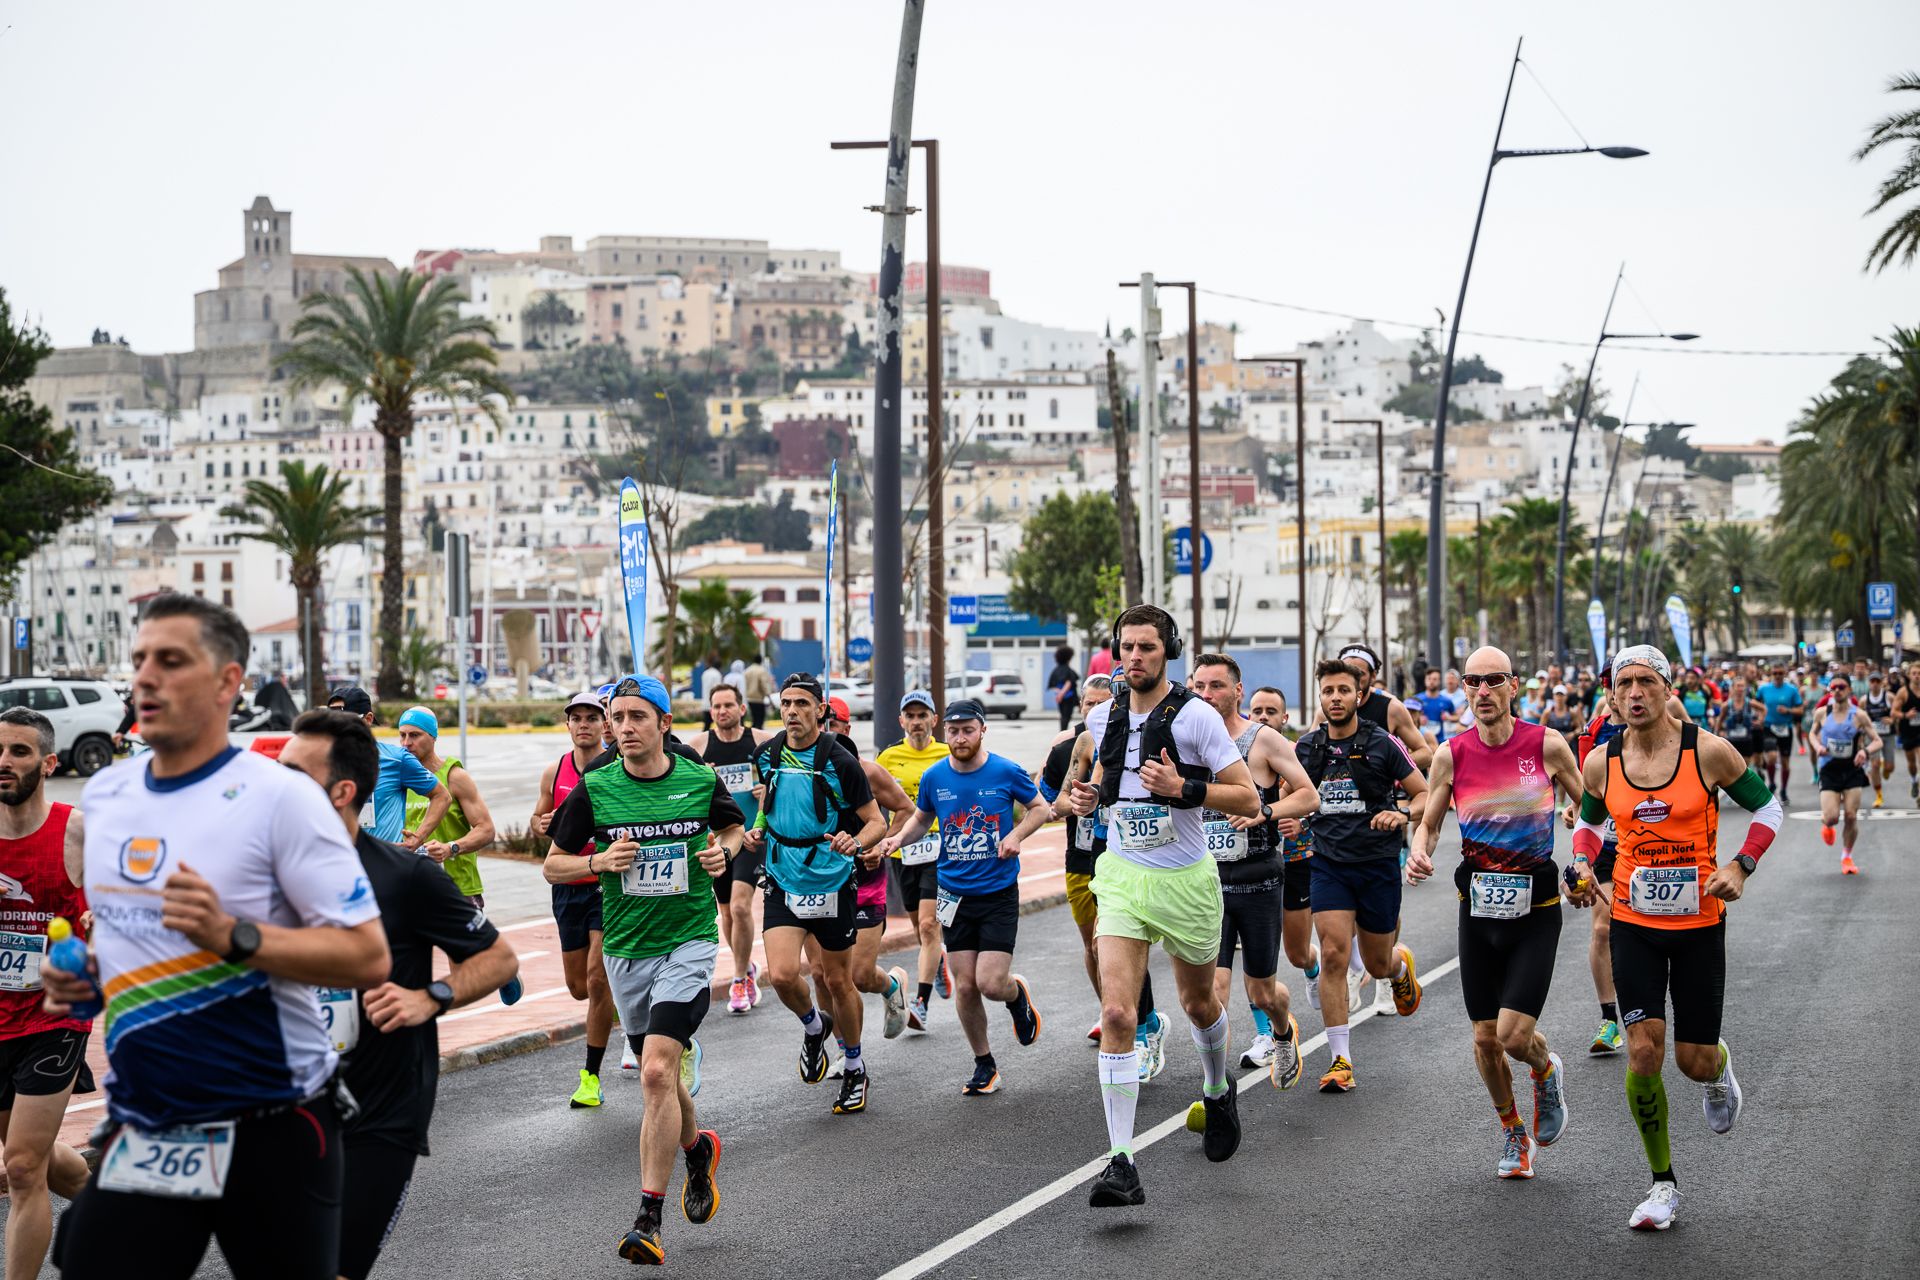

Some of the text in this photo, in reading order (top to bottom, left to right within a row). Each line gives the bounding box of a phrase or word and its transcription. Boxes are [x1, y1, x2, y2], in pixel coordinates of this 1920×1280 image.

[17, 621, 27, 646] P
[723, 773, 745, 785] 123
[1520, 775, 1538, 785] OTSO
[1327, 791, 1354, 805] 296
[1132, 807, 1155, 816] IBIZA
[1128, 819, 1160, 837] 305
[1207, 833, 1236, 850] 836
[645, 847, 671, 857] IBIZA
[910, 842, 933, 856] 210
[1638, 842, 1695, 858] Napoli Nord
[947, 852, 988, 861] BARCELONA
[1650, 855, 1697, 867] Marathon
[636, 861, 674, 881] 114
[1655, 869, 1682, 878] IBIZA
[1493, 875, 1517, 884] IBIZA
[1483, 887, 1518, 906] 332
[1644, 883, 1685, 901] 307
[796, 893, 827, 907] 283
[0, 910, 55, 922] DRINOS
[0, 934, 26, 946] BIZA
[133, 1144, 206, 1177] 266
